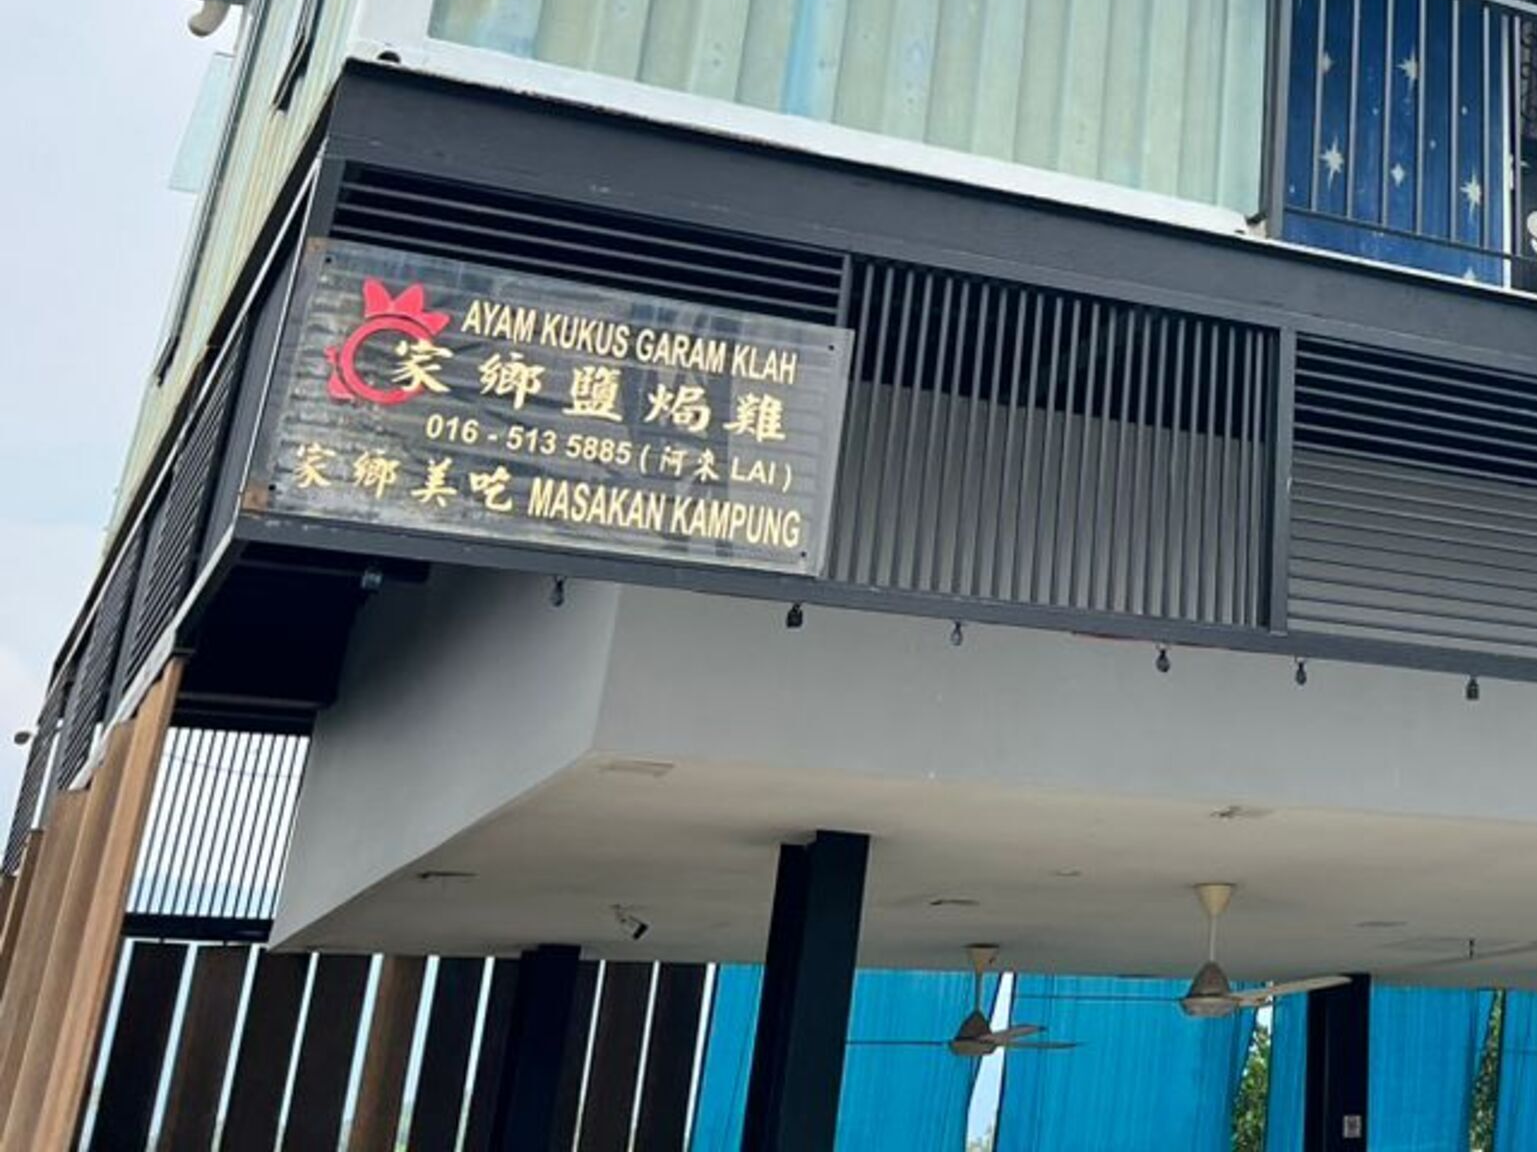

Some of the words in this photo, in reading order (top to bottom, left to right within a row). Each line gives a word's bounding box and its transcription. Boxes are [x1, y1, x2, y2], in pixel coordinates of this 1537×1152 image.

[461, 300, 537, 345] AYAM
[539, 312, 631, 358] KUKUS
[635, 330, 727, 374] GARAM
[730, 344, 797, 386] KLAH
[425, 412, 480, 445] 016
[507, 424, 558, 456] 513
[565, 432, 634, 466] 5885
[526, 477, 667, 532] MASAKAN
[669, 495, 803, 549] KAMPUNG
